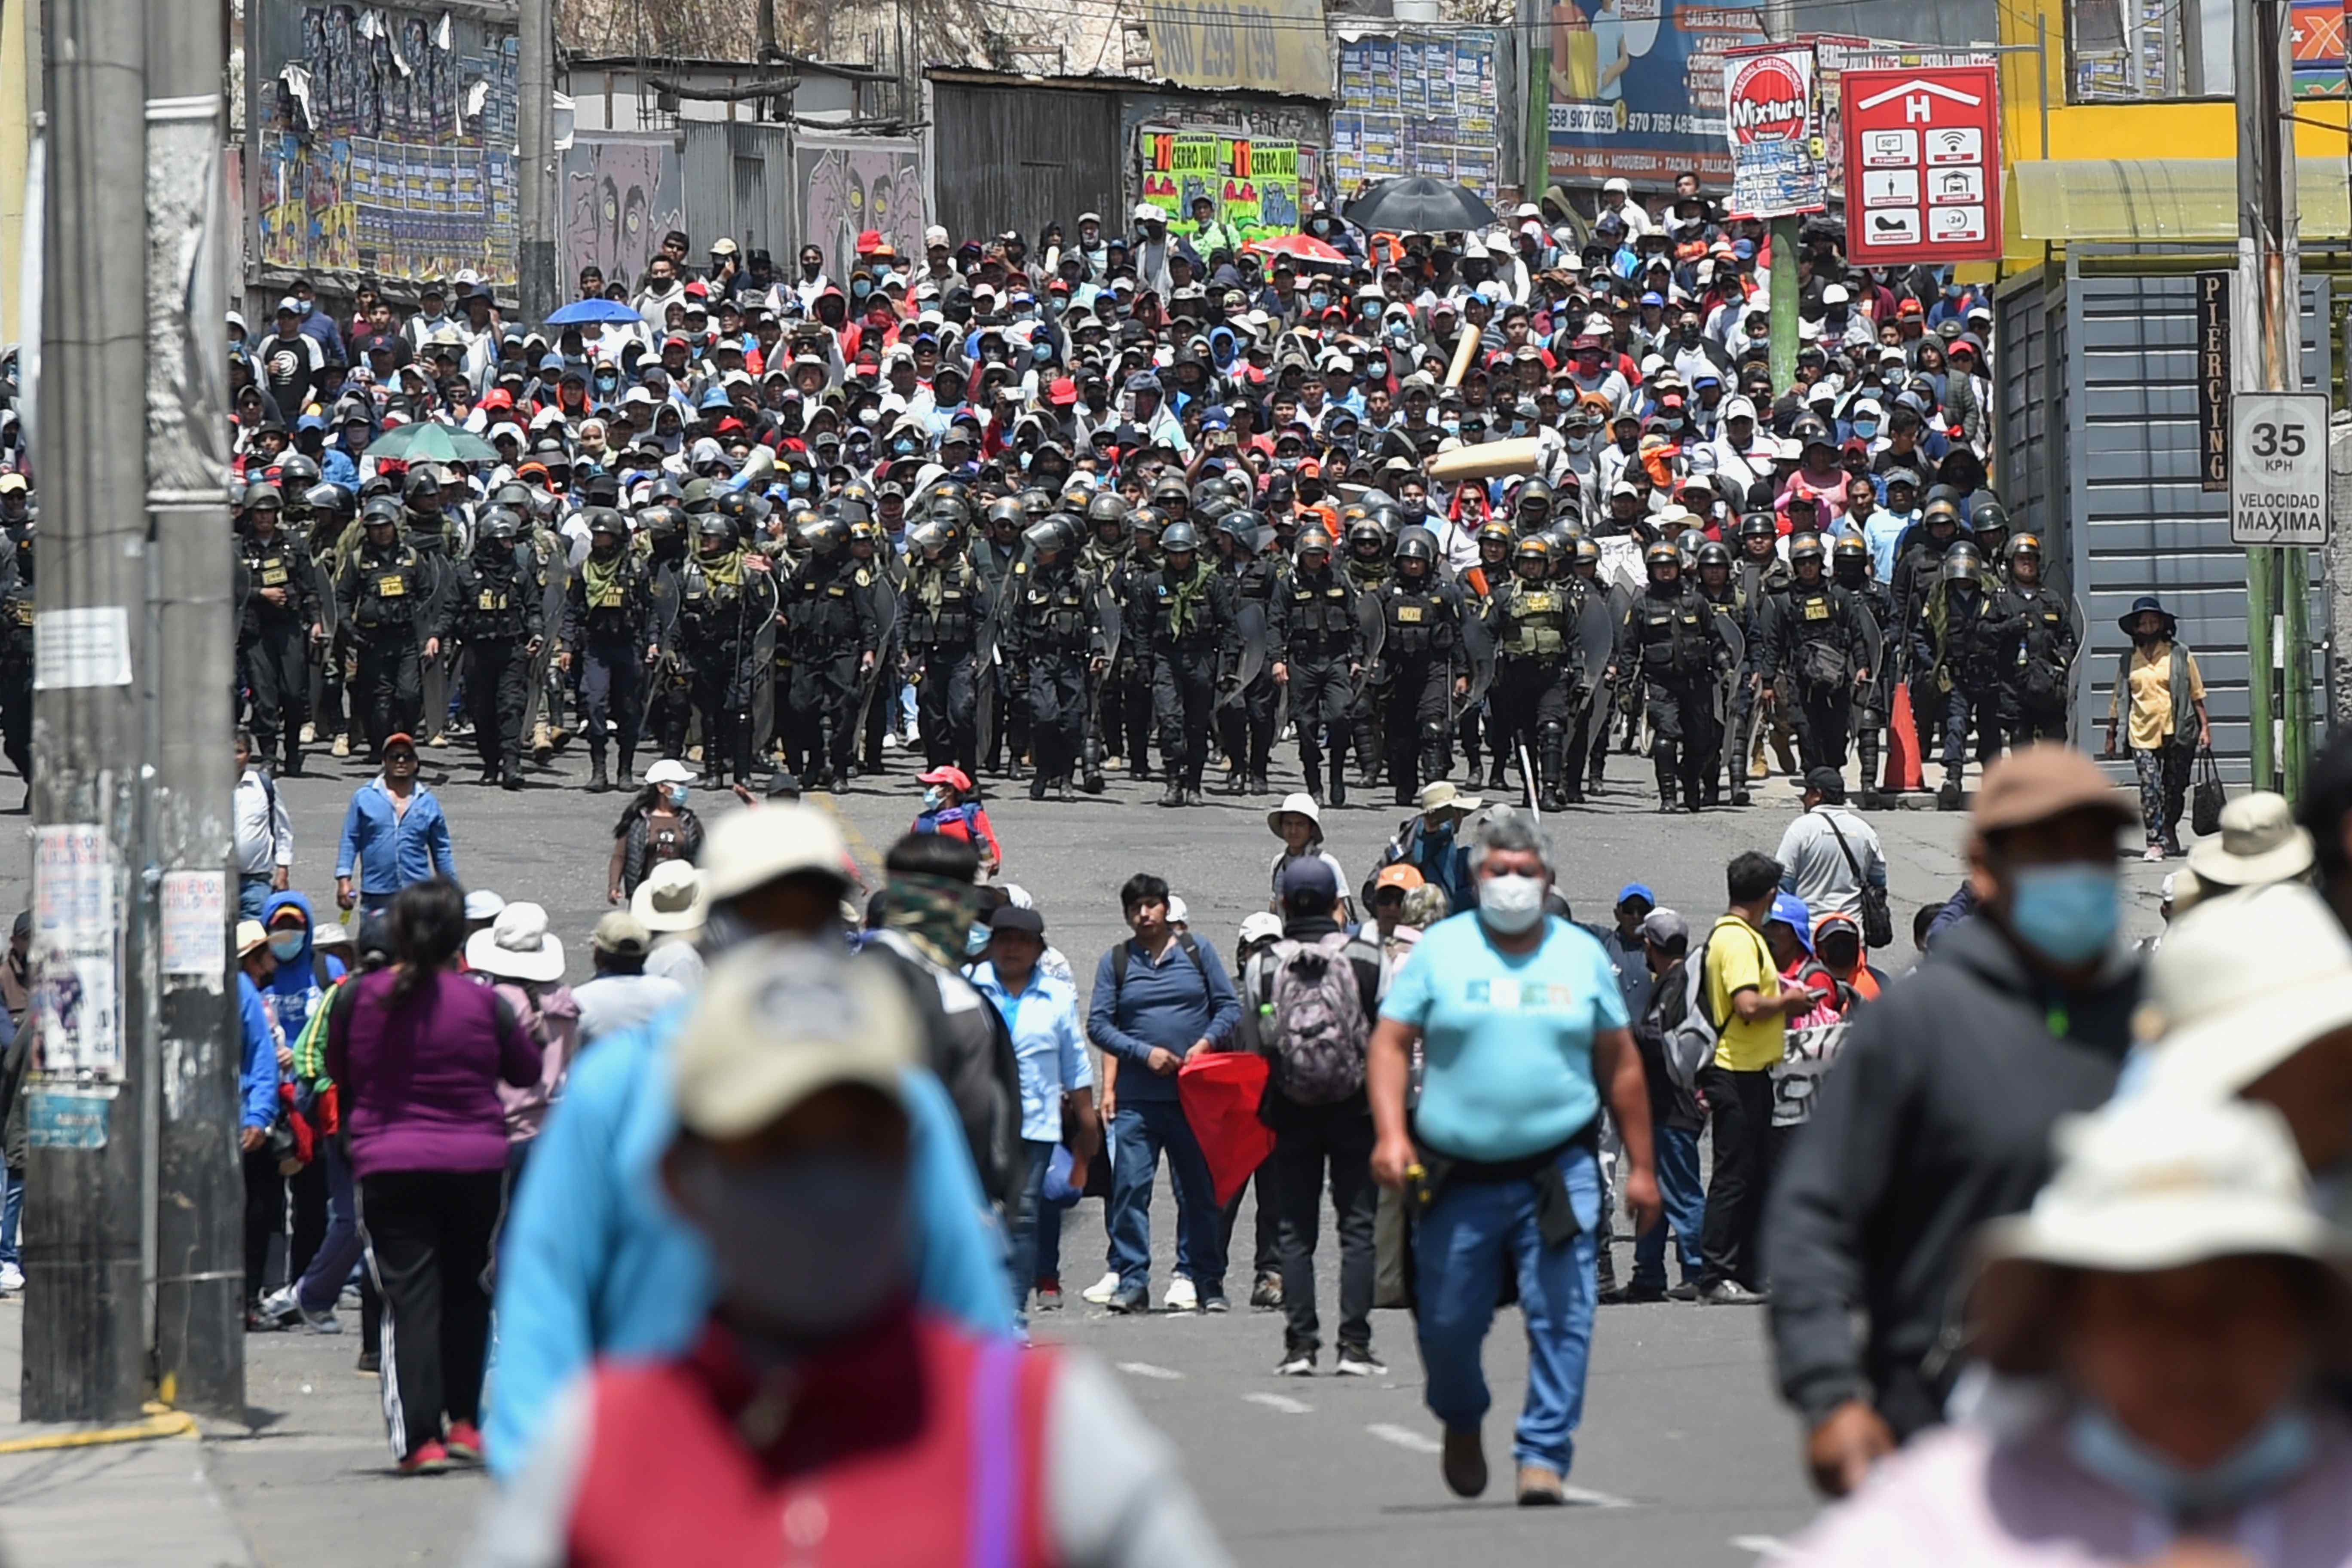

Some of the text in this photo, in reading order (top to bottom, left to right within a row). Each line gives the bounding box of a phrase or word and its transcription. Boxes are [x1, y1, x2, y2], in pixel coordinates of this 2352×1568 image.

[1197, 1, 1235, 77] 299
[1238, 5, 1277, 80] 799
[1570, 110, 1590, 128] 907
[1593, 110, 1612, 130] 050
[1733, 98, 1804, 129] Mixtura
[1906, 95, 1930, 123] H
[1628, 112, 1649, 132] 970
[1652, 113, 1672, 132] 766
[1674, 114, 1694, 134] 489
[1155, 134, 1172, 170] 11
[1172, 145, 1197, 171] CERRO
[1200, 147, 1216, 170] JULI
[1233, 141, 1250, 178] 11
[1251, 151, 1278, 174] CERRO
[1279, 152, 1296, 174] JULI
[2205, 277, 2225, 481] PIERCING
[2252, 423, 2306, 457] 35
[2265, 459, 2293, 472] KPH
[2239, 493, 2320, 509] VELOCIDAD
[2238, 511, 2321, 531] MAXIMA
